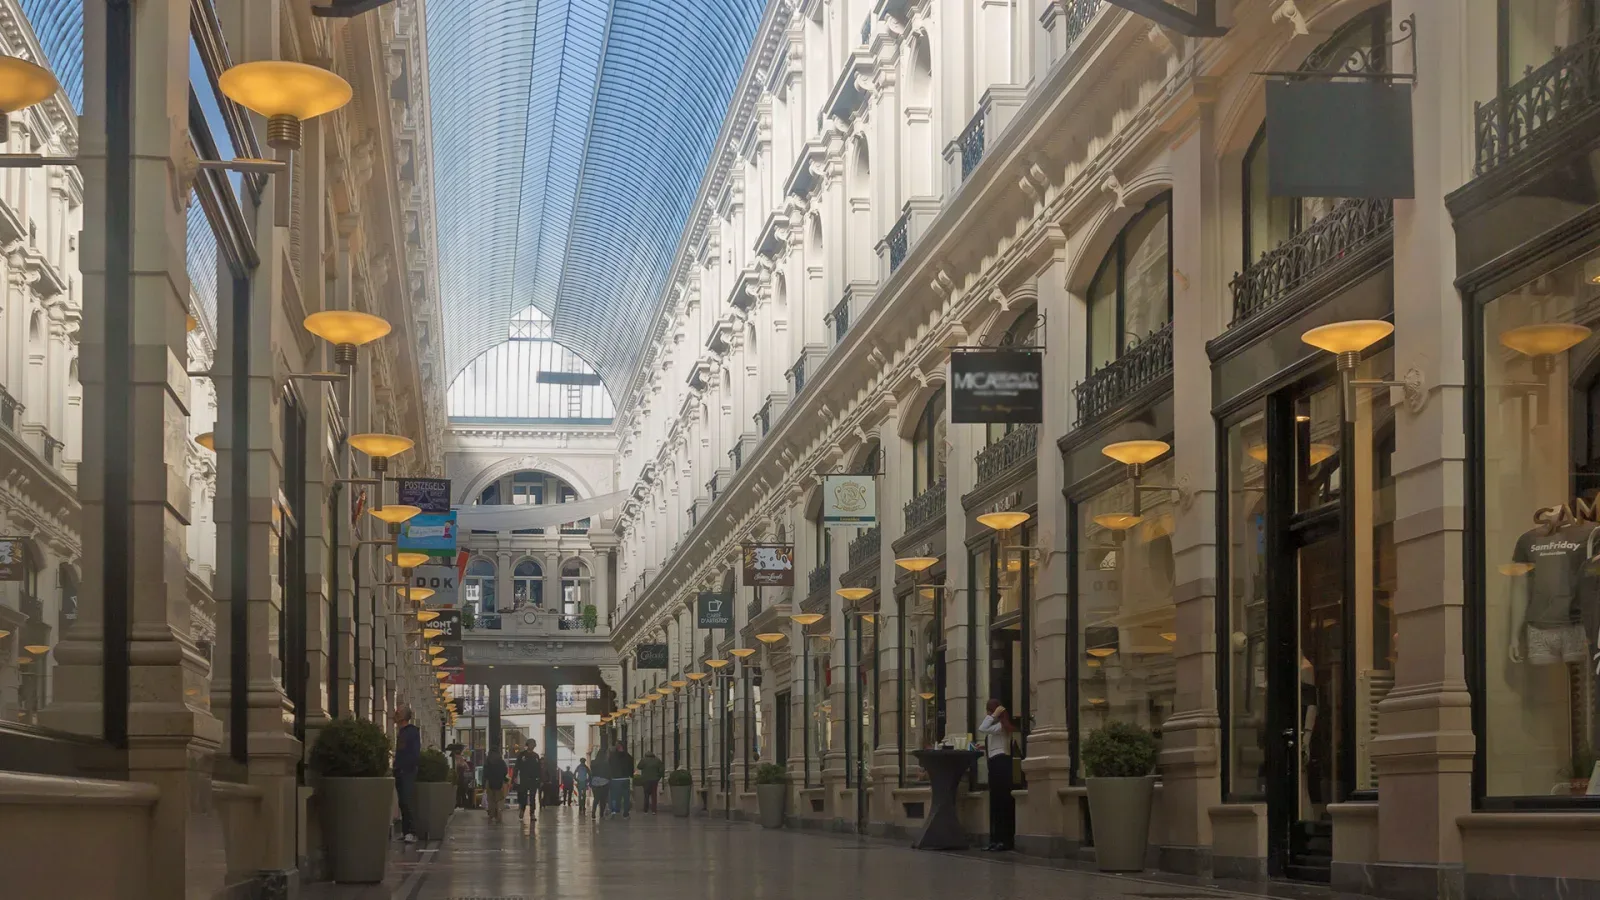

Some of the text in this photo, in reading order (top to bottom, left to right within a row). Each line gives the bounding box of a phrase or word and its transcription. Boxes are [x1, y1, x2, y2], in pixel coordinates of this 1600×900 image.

[404, 481, 446, 491] POSTZEGELS
[1530, 540, 1580, 552] SamFriday
[416, 577, 453, 588] DOK
[426, 620, 452, 629] MONT
